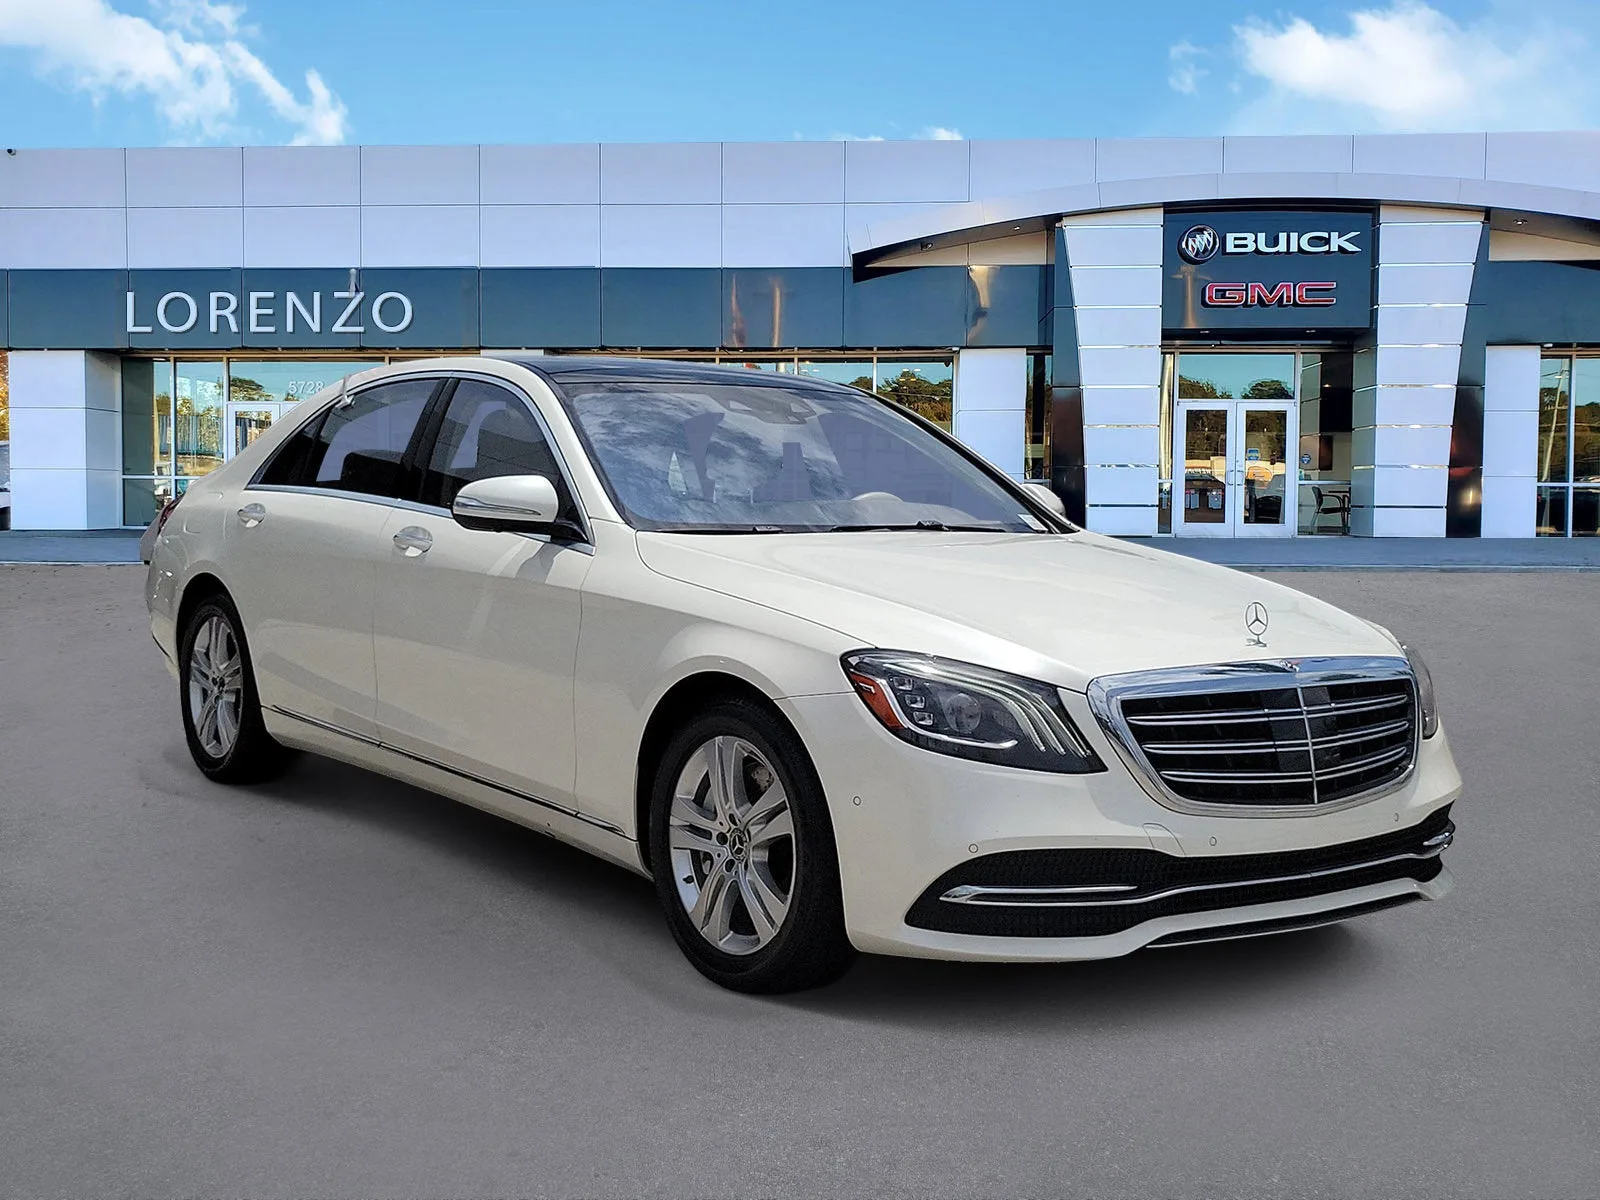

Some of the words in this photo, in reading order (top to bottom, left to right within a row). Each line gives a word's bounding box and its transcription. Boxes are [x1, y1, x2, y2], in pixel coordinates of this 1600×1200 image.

[1225, 231, 1362, 253] BUICK
[1204, 281, 1337, 306] GMC
[126, 291, 414, 333] LORENZO
[288, 380, 325, 394] 5728
